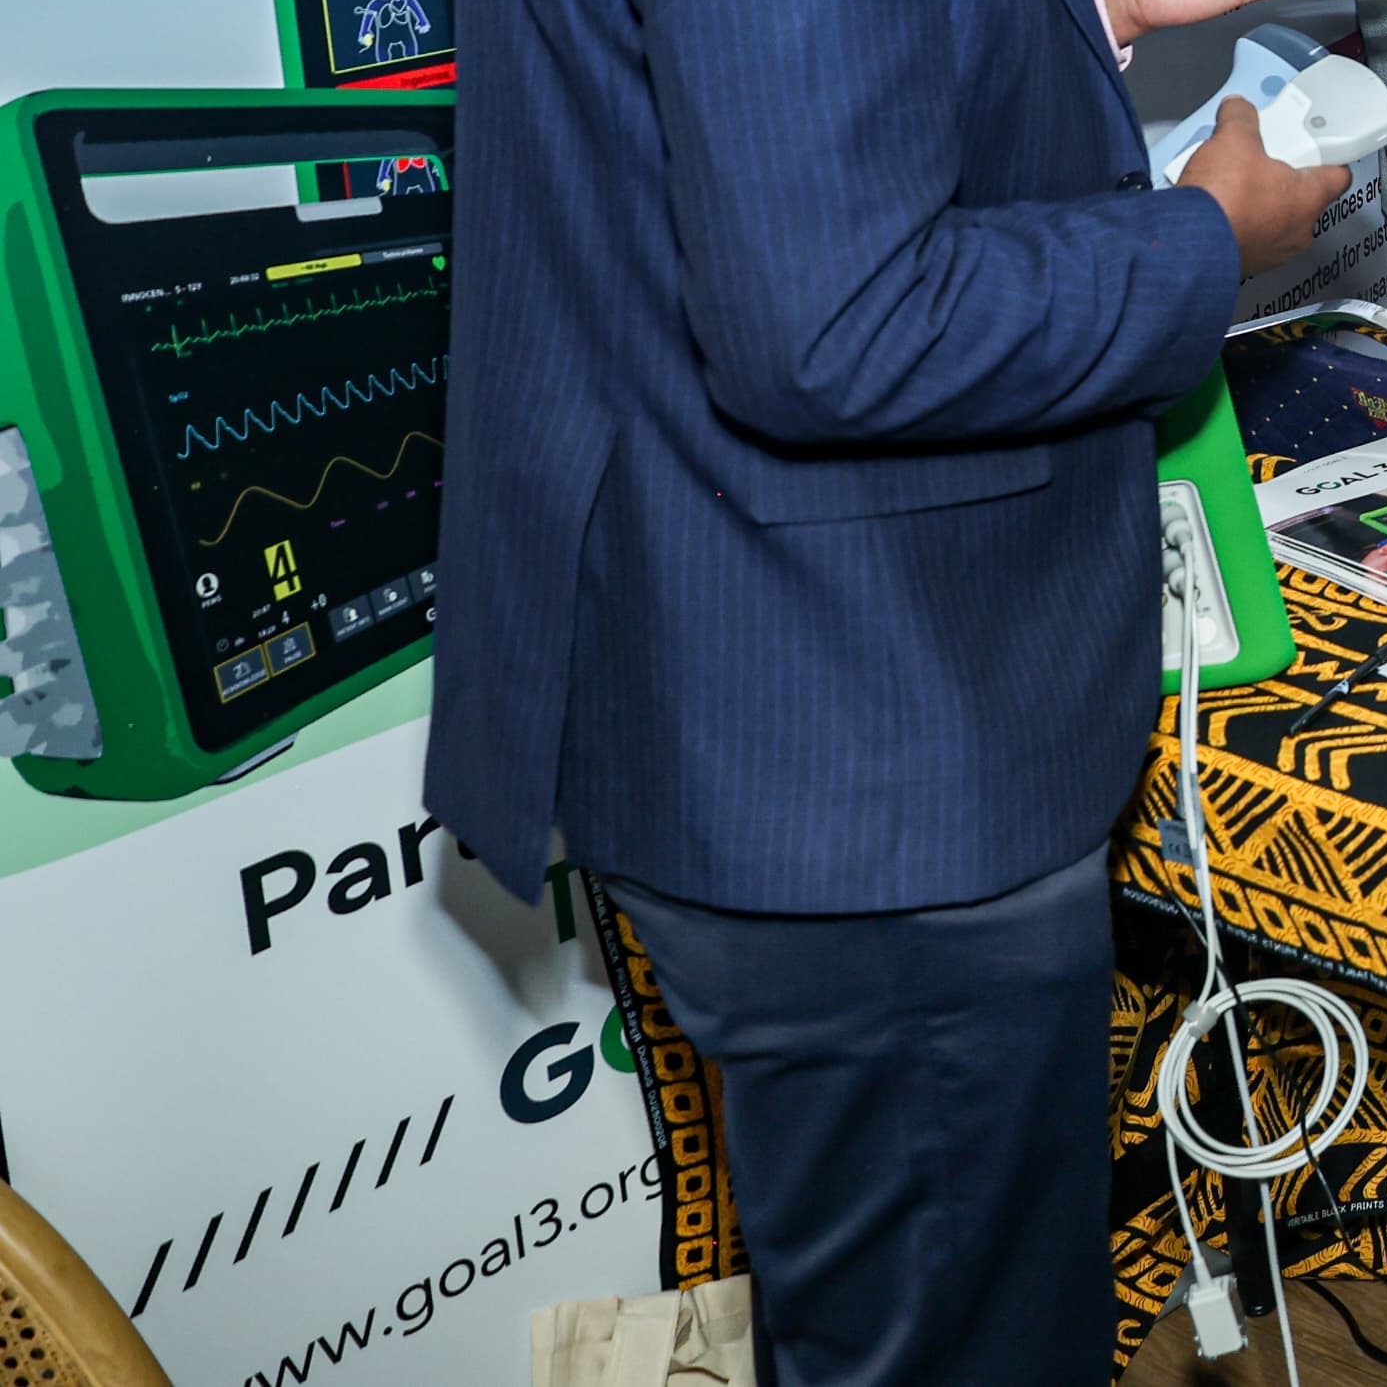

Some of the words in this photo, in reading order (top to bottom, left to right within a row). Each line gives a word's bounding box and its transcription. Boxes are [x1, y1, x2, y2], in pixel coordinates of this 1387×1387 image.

[1342, 242, 1361, 274] for
[1296, 471, 1379, 495] GOAL
[1349, 1200, 1385, 1212] PRINTS
